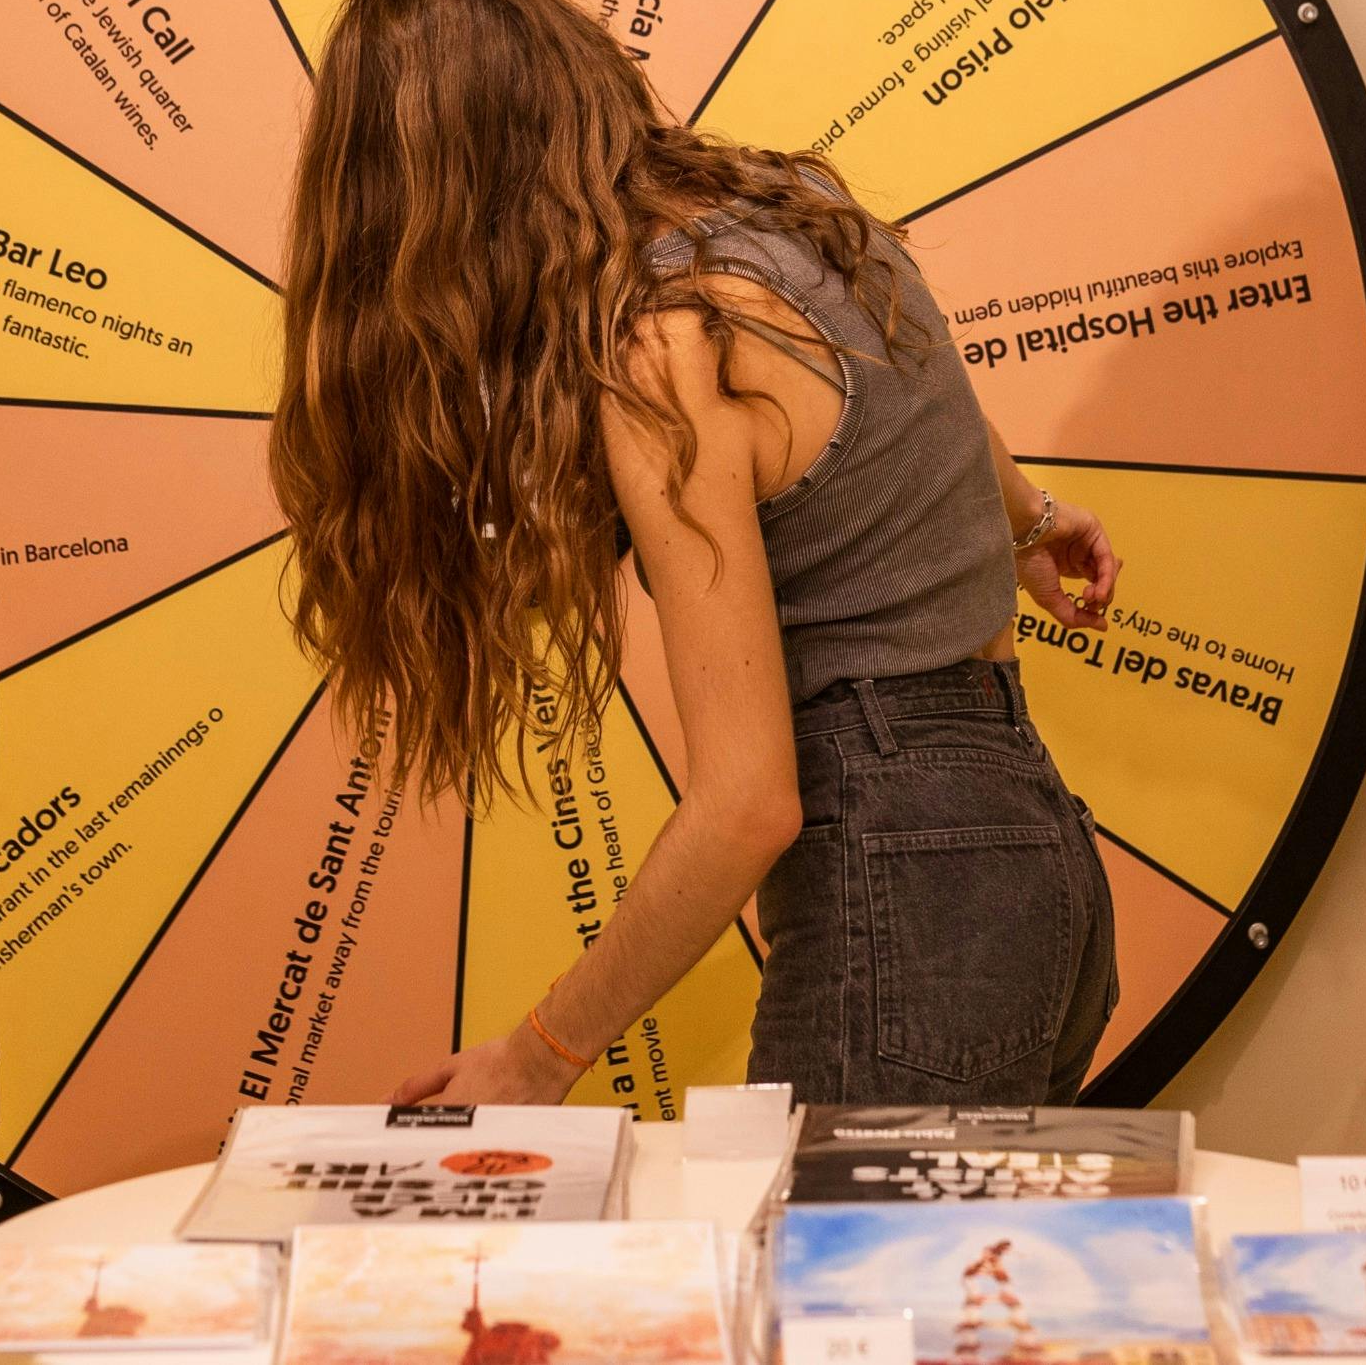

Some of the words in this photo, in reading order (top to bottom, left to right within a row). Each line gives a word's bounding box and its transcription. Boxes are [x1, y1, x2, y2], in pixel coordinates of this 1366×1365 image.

[141, 6, 196, 66] Call
[913, 7, 977, 63] visiting
[46, 2, 72, 24] of
[64, 22, 117, 92] Catalan
[114, 90, 158, 151] wines.
[91, 6, 143, 69] Jewish
[138, 68, 194, 133] quarter
[901, 59, 917, 74] a
[922, 26, 1014, 106] Prison
[845, 71, 906, 127] former
[48, 248, 108, 291] Leo
[1182, 257, 1221, 281] this
[1224, 239, 1304, 269] Explore
[1007, 286, 1083, 314] hidden
[1086, 266, 1179, 303] beautiful
[1226, 273, 1312, 312] Enter
[2, 278, 97, 325] flamenco
[101, 314, 164, 347] nights
[167, 337, 193, 357] an
[954, 298, 1003, 325] gem
[1162, 293, 1219, 326] the
[2, 314, 89, 360] fantastic.
[963, 337, 1008, 369] de
[1015, 306, 1156, 363] Hospital
[0, 546, 20, 566] in
[24, 537, 129, 563] Barcelona
[1014, 611, 1105, 669] Tomá
[1111, 608, 1163, 638] city's
[1166, 626, 1201, 652] the
[1111, 645, 1168, 685] del
[1204, 639, 1227, 661] to
[1231, 647, 1295, 685] Home
[1173, 664, 1284, 727] Bravas
[546, 758, 584, 851] Cines
[589, 788, 612, 813] of
[26, 866, 51, 887] in
[46, 840, 80, 869] the
[74, 810, 112, 843] last
[307, 820, 356, 894] Sant
[359, 842, 385, 876] the
[598, 815, 625, 872] heart
[69, 842, 133, 897] town.
[565, 858, 598, 915] the
[293, 900, 329, 945] de
[340, 880, 373, 930] from
[325, 932, 358, 990] away
[249, 949, 313, 1067] Mercat
[299, 991, 336, 1065] market
[640, 1017, 669, 1084] movie
[238, 1069, 273, 1102] El
